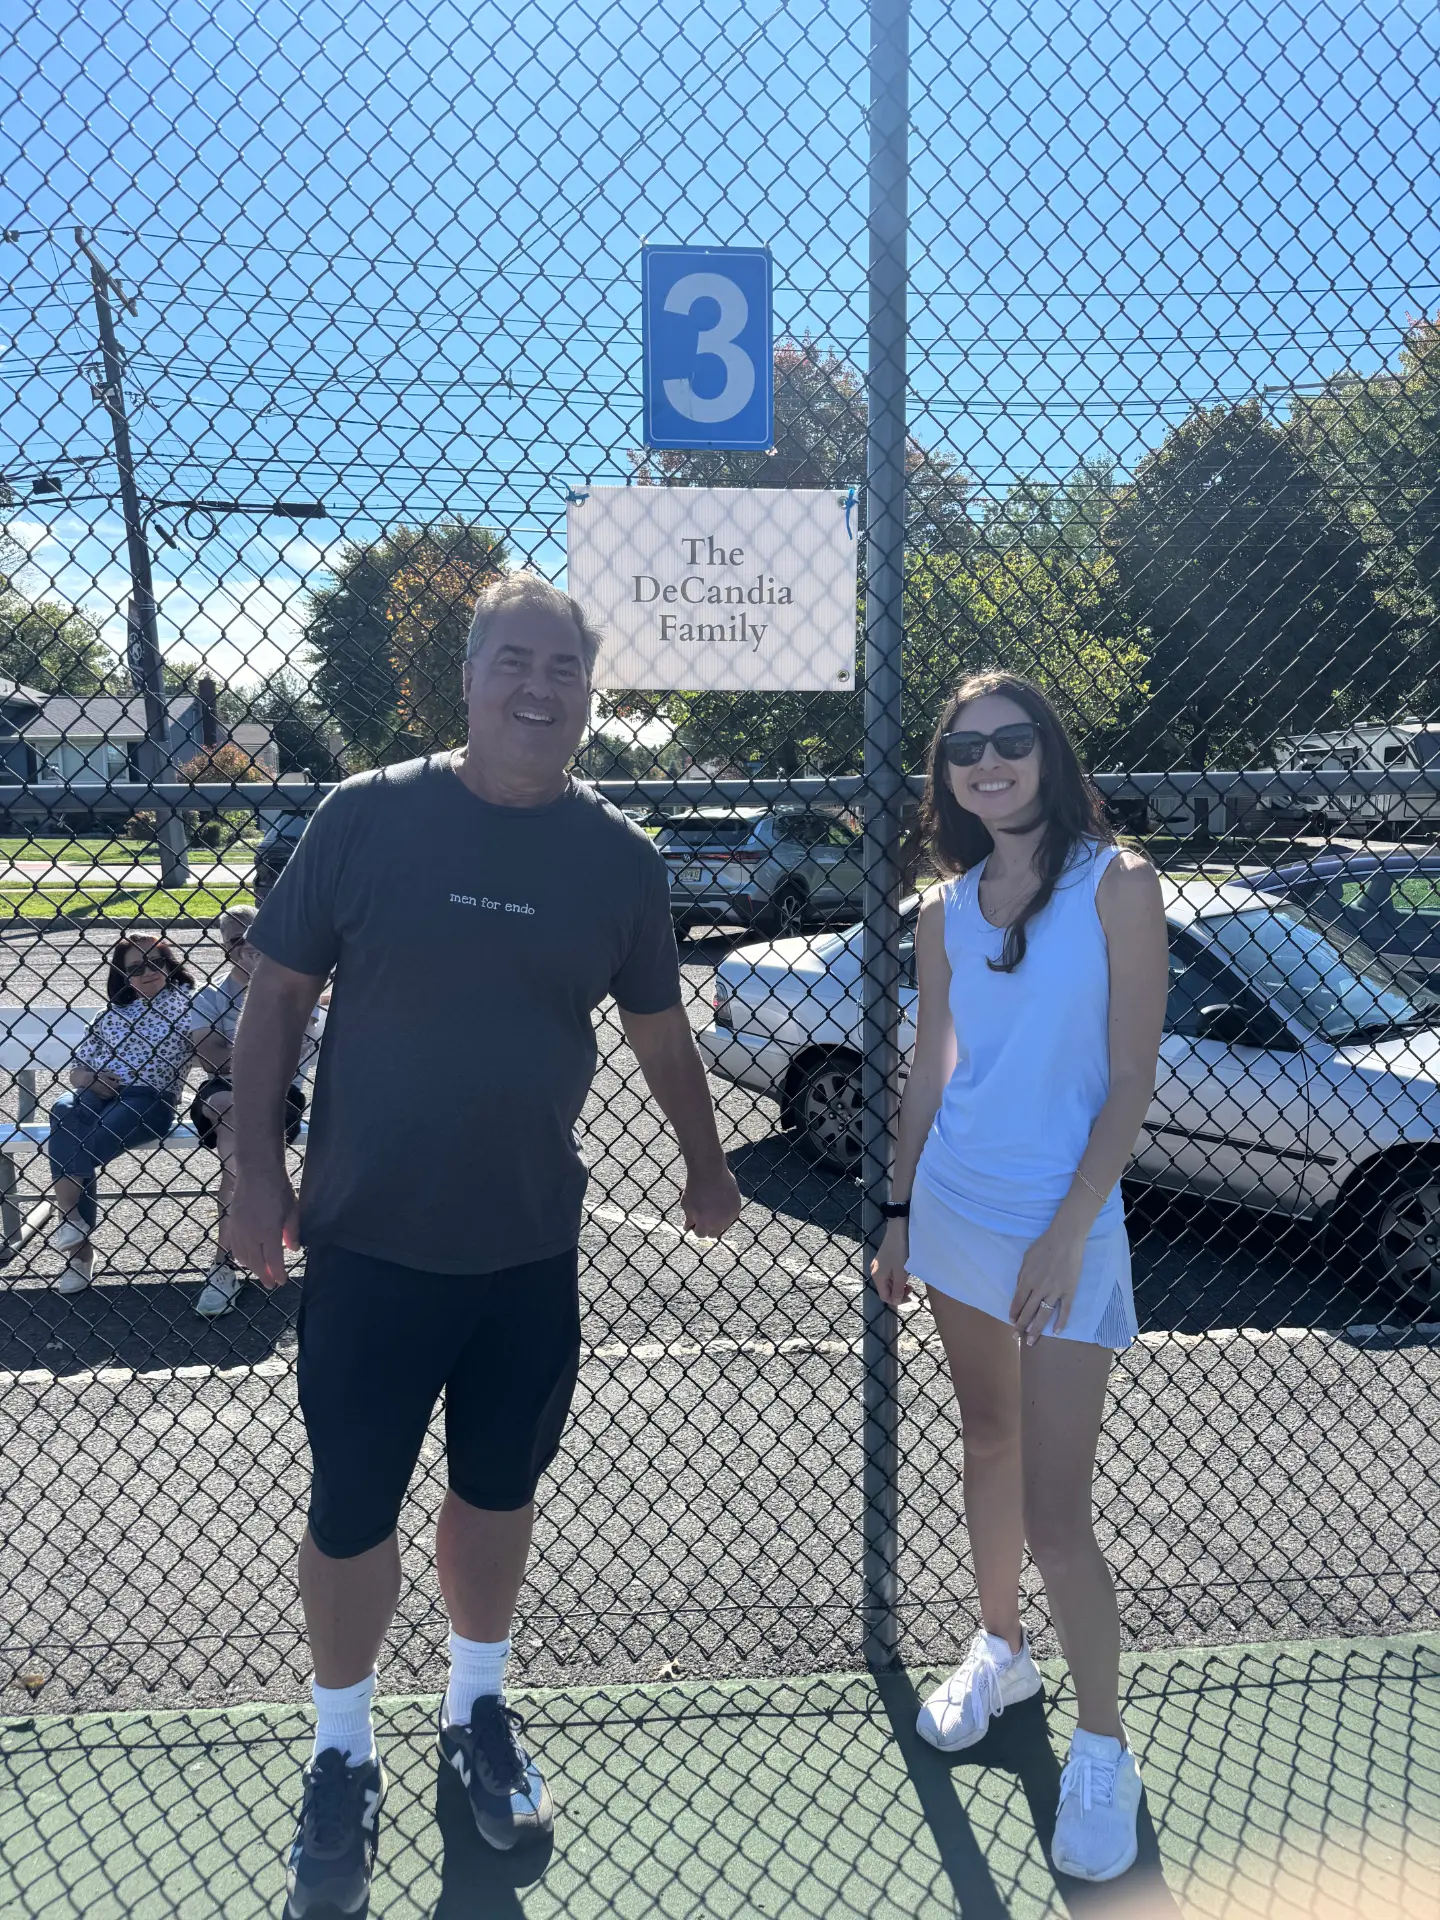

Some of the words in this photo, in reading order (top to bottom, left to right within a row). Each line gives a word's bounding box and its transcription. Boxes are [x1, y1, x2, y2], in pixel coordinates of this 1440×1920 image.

[663, 272, 756, 424] 3
[681, 535, 745, 566] The
[632, 575, 795, 605] DeCandia
[658, 611, 769, 652] Family
[449, 893, 477, 906] men
[481, 897, 501, 910] for
[504, 903, 535, 915] endo
